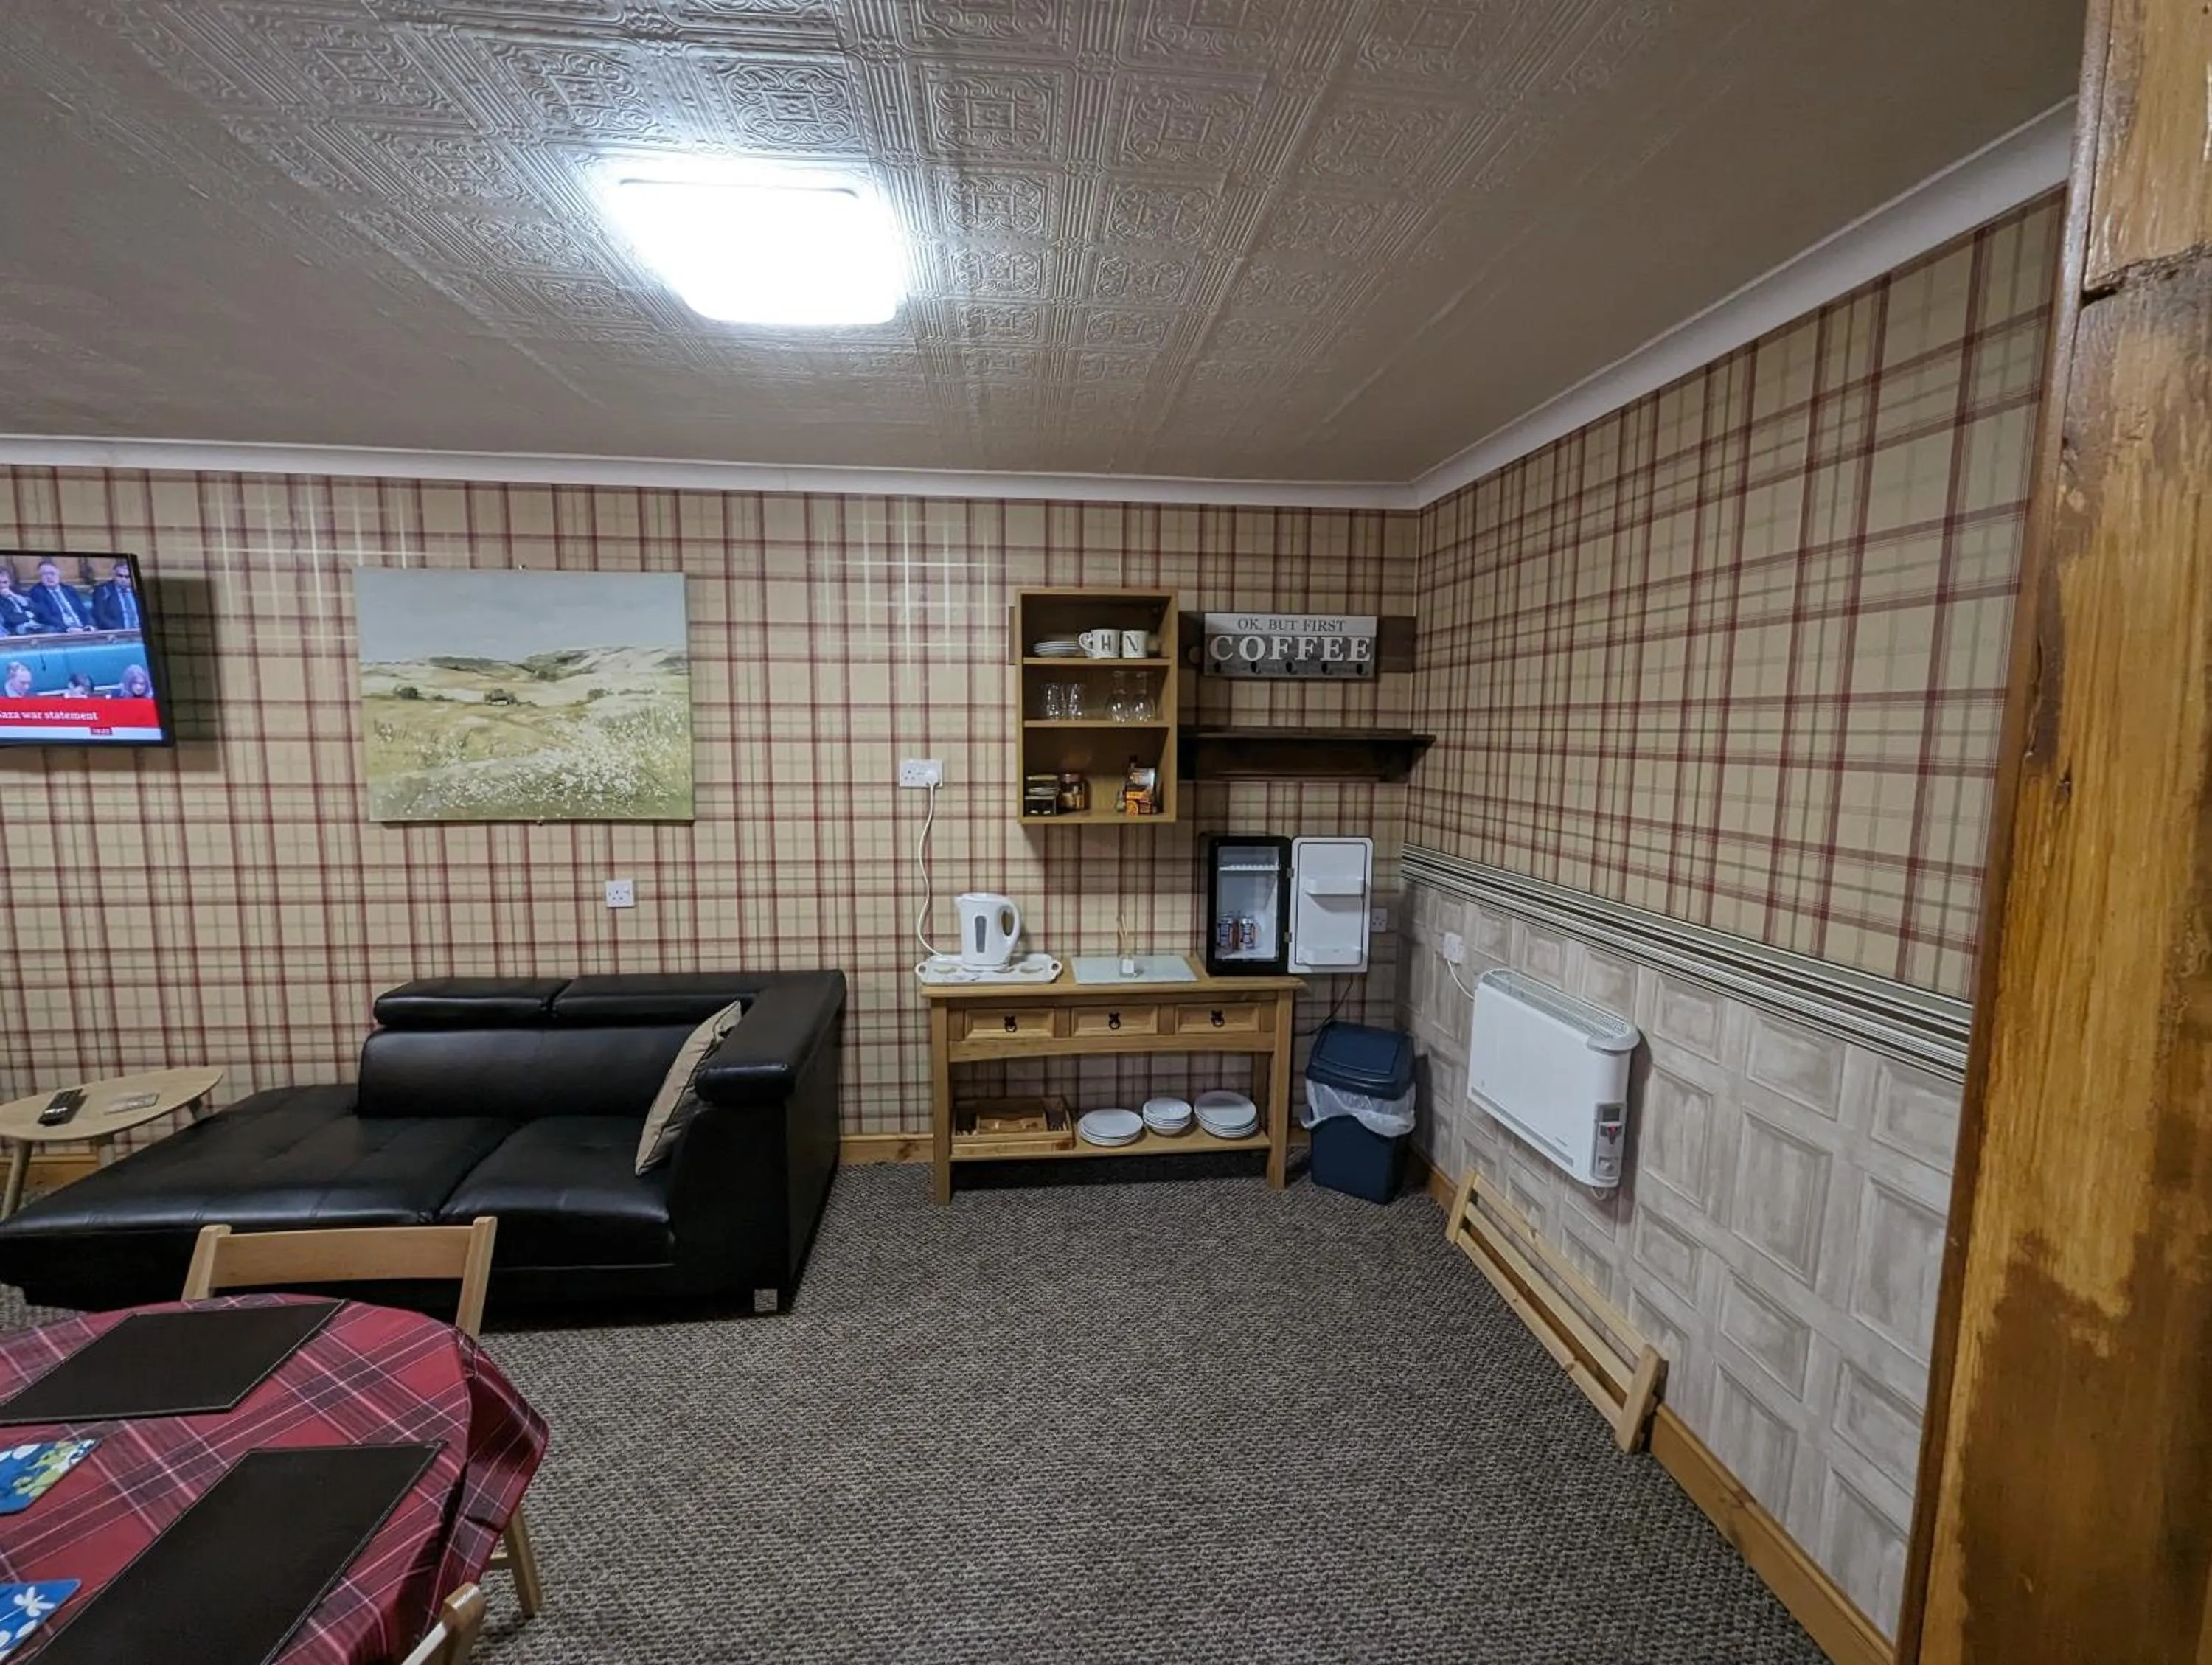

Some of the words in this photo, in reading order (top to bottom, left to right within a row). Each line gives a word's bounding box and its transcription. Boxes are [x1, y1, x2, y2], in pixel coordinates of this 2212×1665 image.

[1269, 619, 1298, 631] BUT
[1302, 619, 1346, 632] FIRST
[1101, 634, 1111, 652] H
[1210, 635, 1371, 661] COFFEE
[21, 711, 43, 720] war
[44, 710, 98, 720] statement
